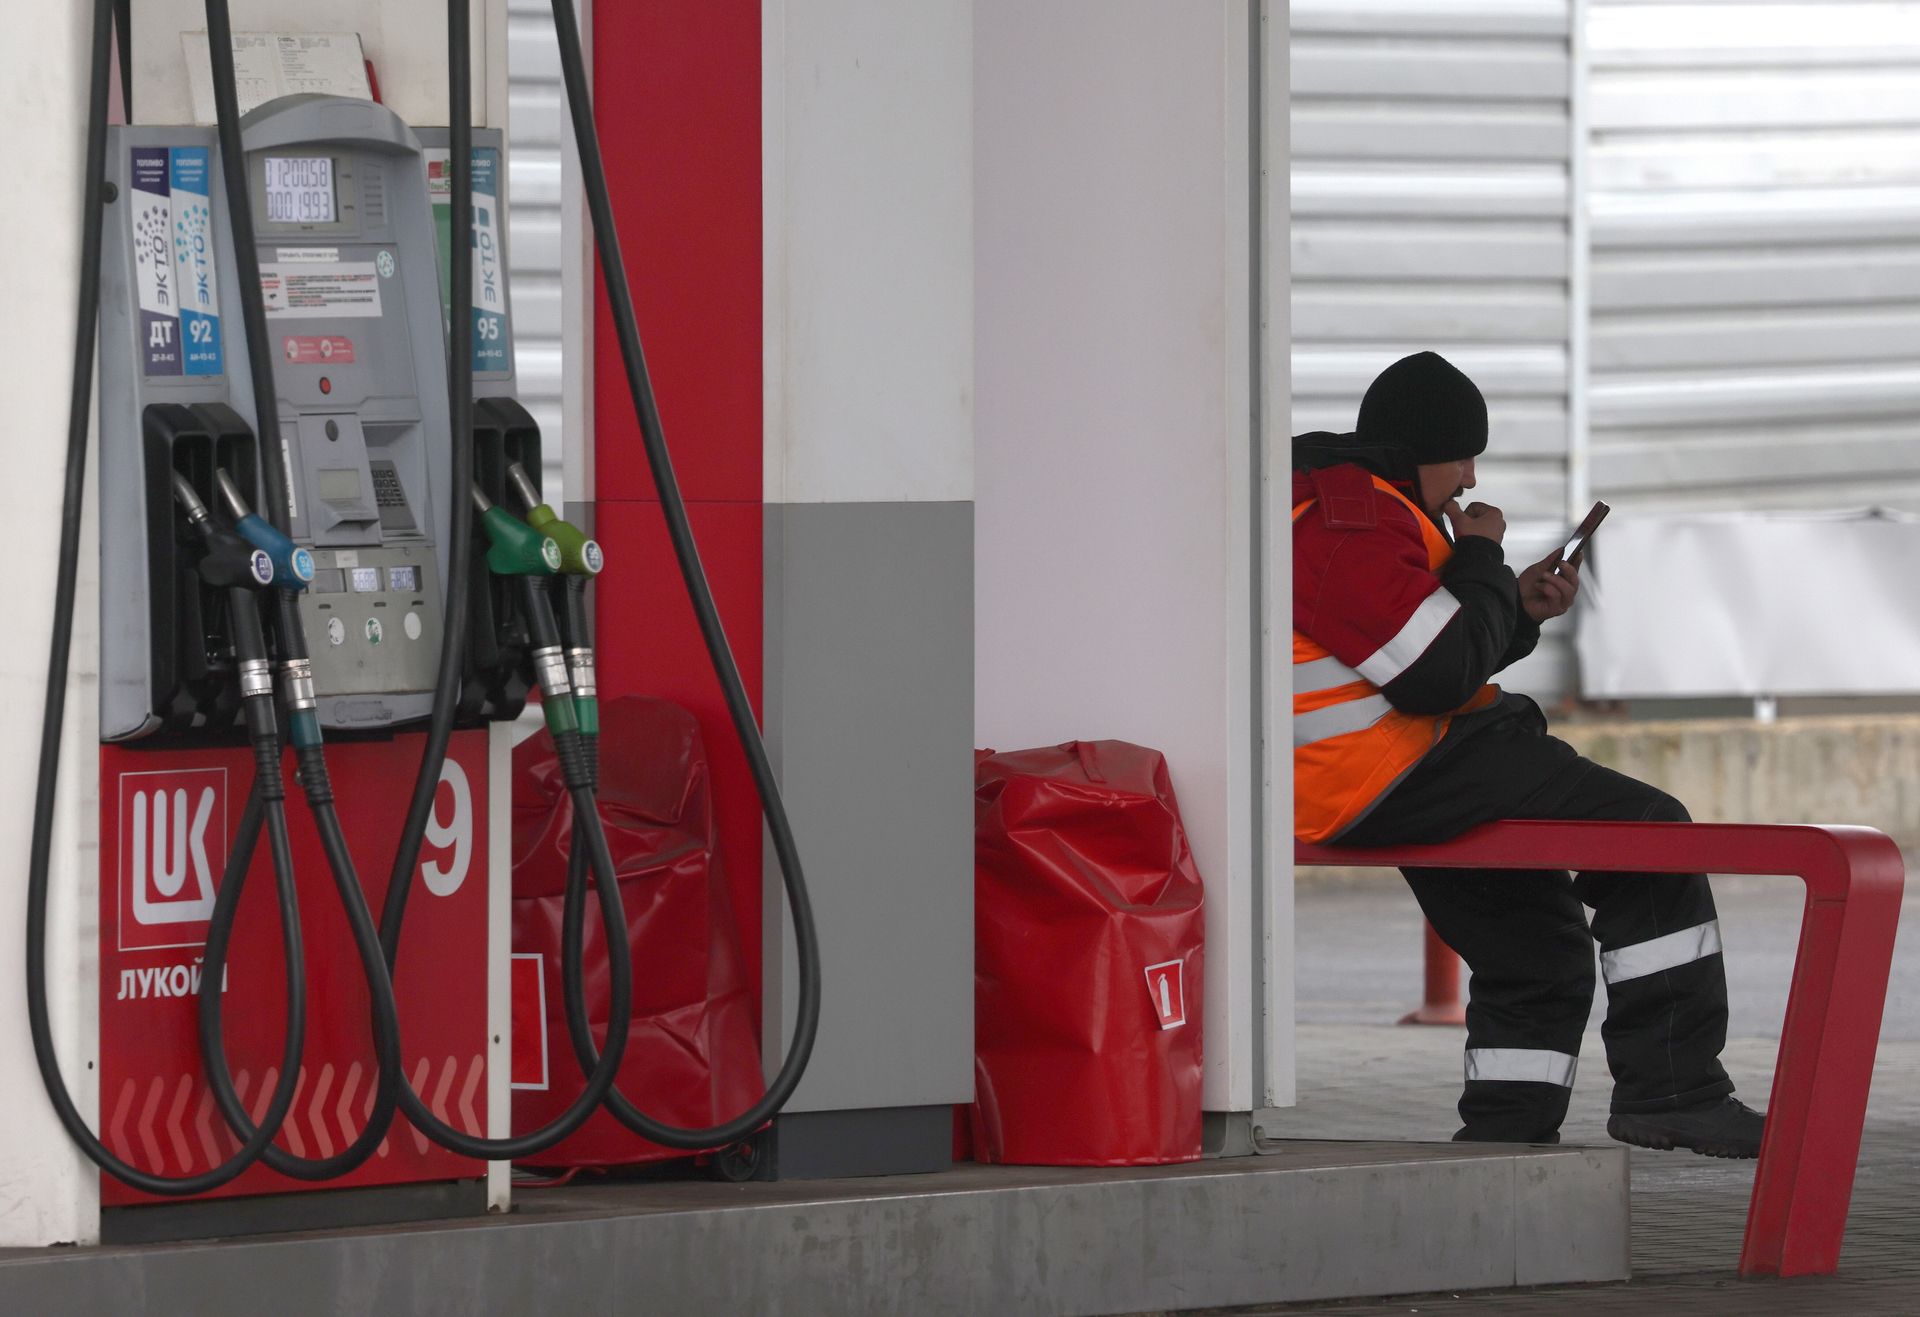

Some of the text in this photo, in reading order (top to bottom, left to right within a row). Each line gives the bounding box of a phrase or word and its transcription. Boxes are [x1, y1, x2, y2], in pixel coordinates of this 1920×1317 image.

[149, 320, 173, 348] ДТ
[190, 319, 213, 343] 92
[477, 317, 499, 340] 95
[420, 757, 473, 897] 9
